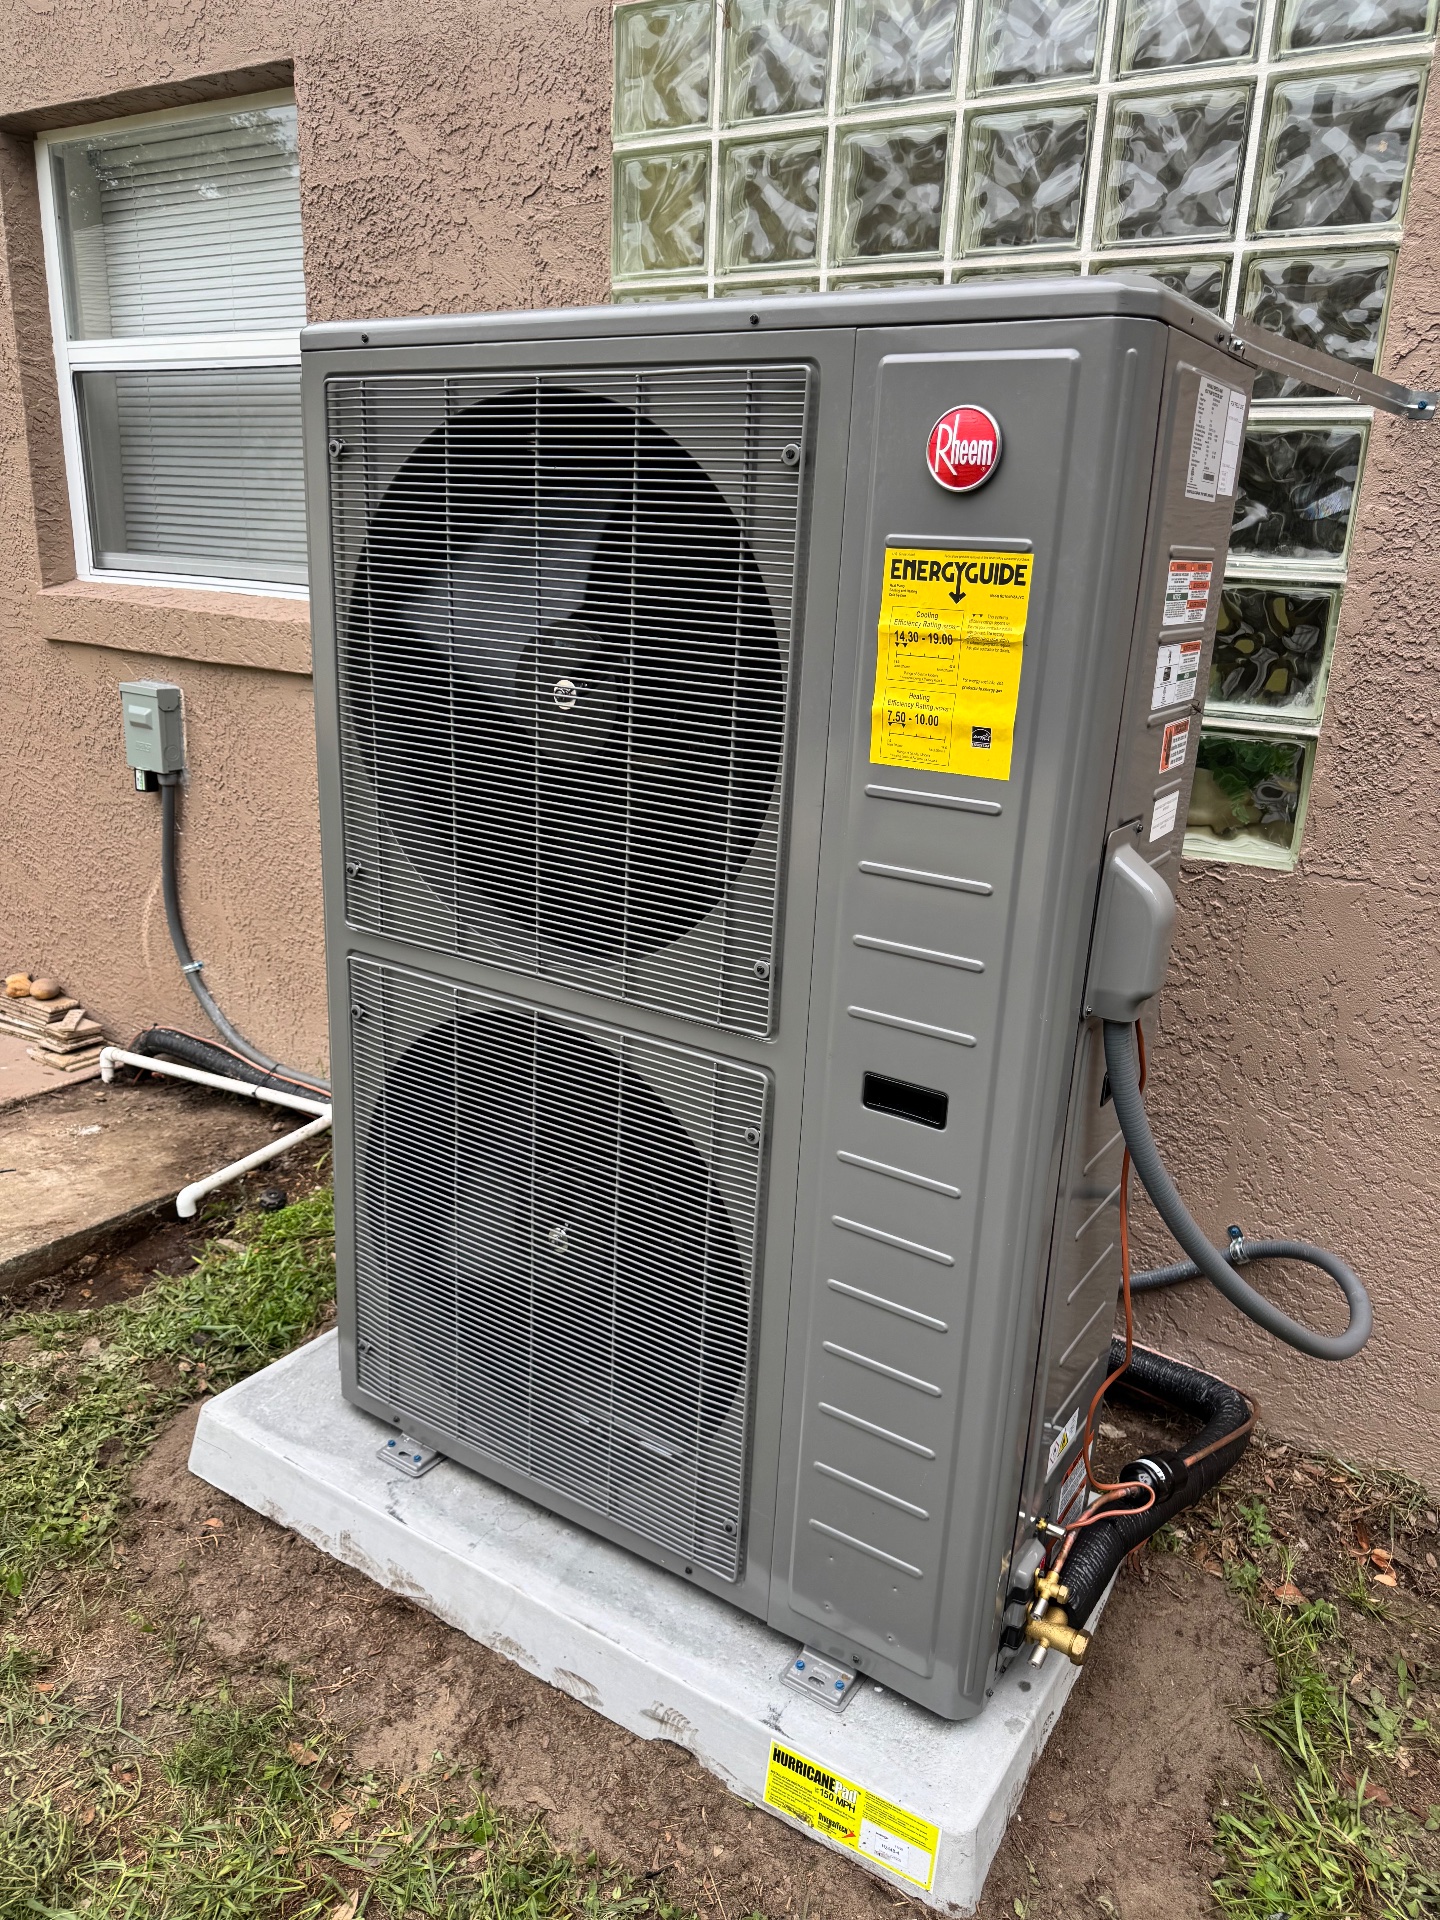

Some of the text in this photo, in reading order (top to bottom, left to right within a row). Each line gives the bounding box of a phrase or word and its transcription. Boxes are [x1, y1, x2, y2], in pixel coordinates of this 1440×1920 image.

[935, 413, 993, 476] Rheem
[890, 558, 1028, 588] ENERGYGUIDE
[916, 611, 938, 620] Cooling
[894, 618, 922, 628] Efficiency
[923, 620, 942, 630] Rating
[894, 630, 919, 643] 14.30
[928, 633, 953, 645] 19.00
[909, 692, 930, 702] Heating
[887, 699, 914, 709] Efficiency
[915, 702, 934, 711] Rating
[887, 709, 906, 722] 7.50
[915, 713, 939, 726] 10.00
[820, 1788, 834, 1802] 150
[836, 1797, 856, 1813] MPH
